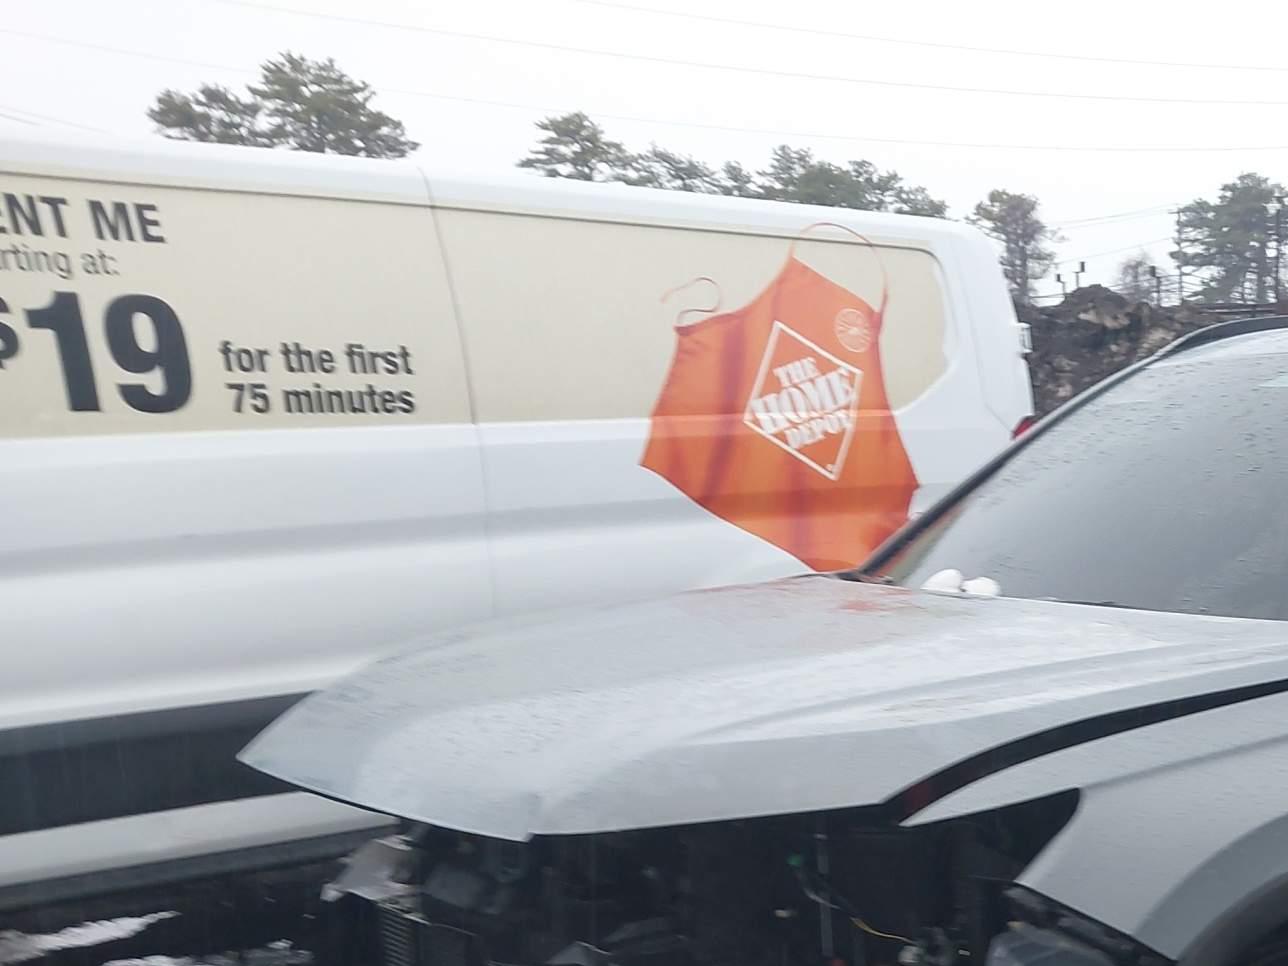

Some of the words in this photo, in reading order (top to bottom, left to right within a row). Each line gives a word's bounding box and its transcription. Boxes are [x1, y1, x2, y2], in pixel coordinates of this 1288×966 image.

[87, 199, 168, 243] ME
[0, 243, 72, 279] rting
[81, 248, 120, 276] at:
[218, 340, 270, 373] for
[280, 342, 336, 374] the
[344, 343, 415, 375] first
[773, 357, 819, 387] THE
[225, 383, 271, 414] 75
[282, 383, 416, 414] minutes
[750, 367, 854, 434] HOME
[784, 409, 851, 449] DEPOT
